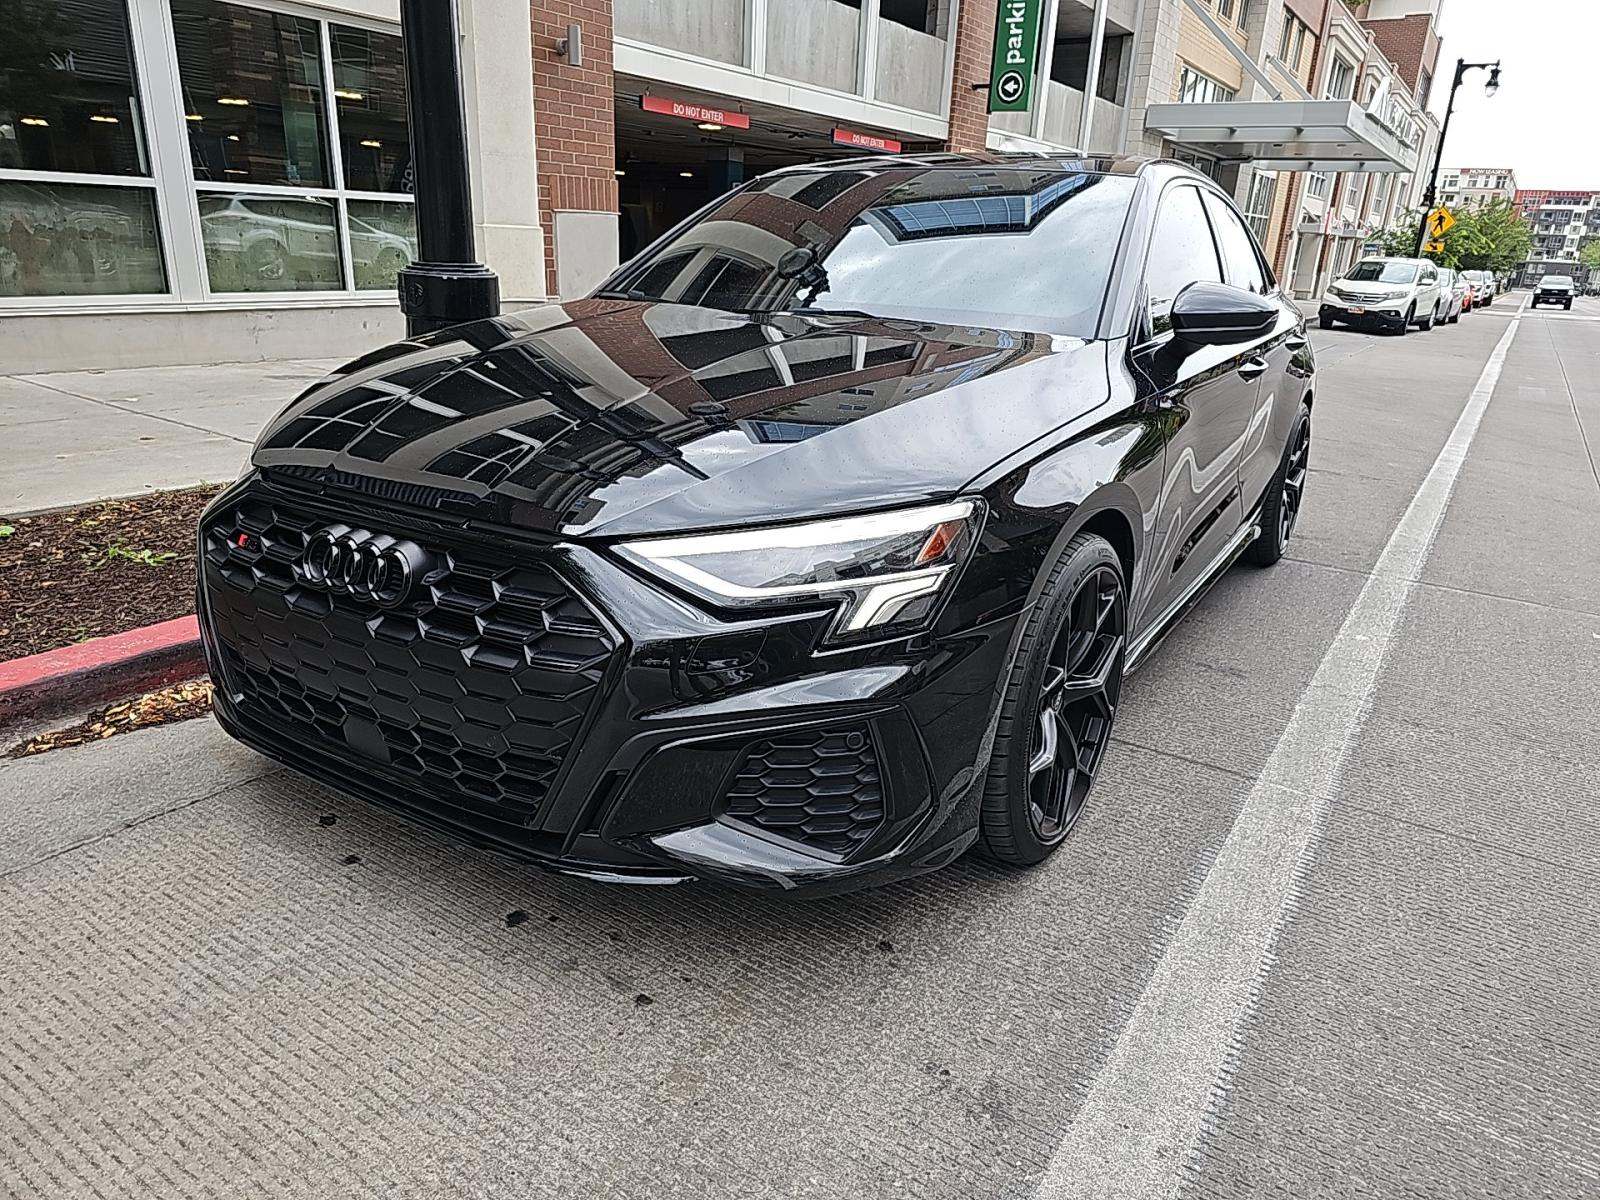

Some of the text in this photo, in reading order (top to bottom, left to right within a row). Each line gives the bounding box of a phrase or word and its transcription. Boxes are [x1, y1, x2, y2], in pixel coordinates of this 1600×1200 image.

[1005, 0, 1026, 64] parki
[673, 103, 724, 123] DO NOT ENTER
